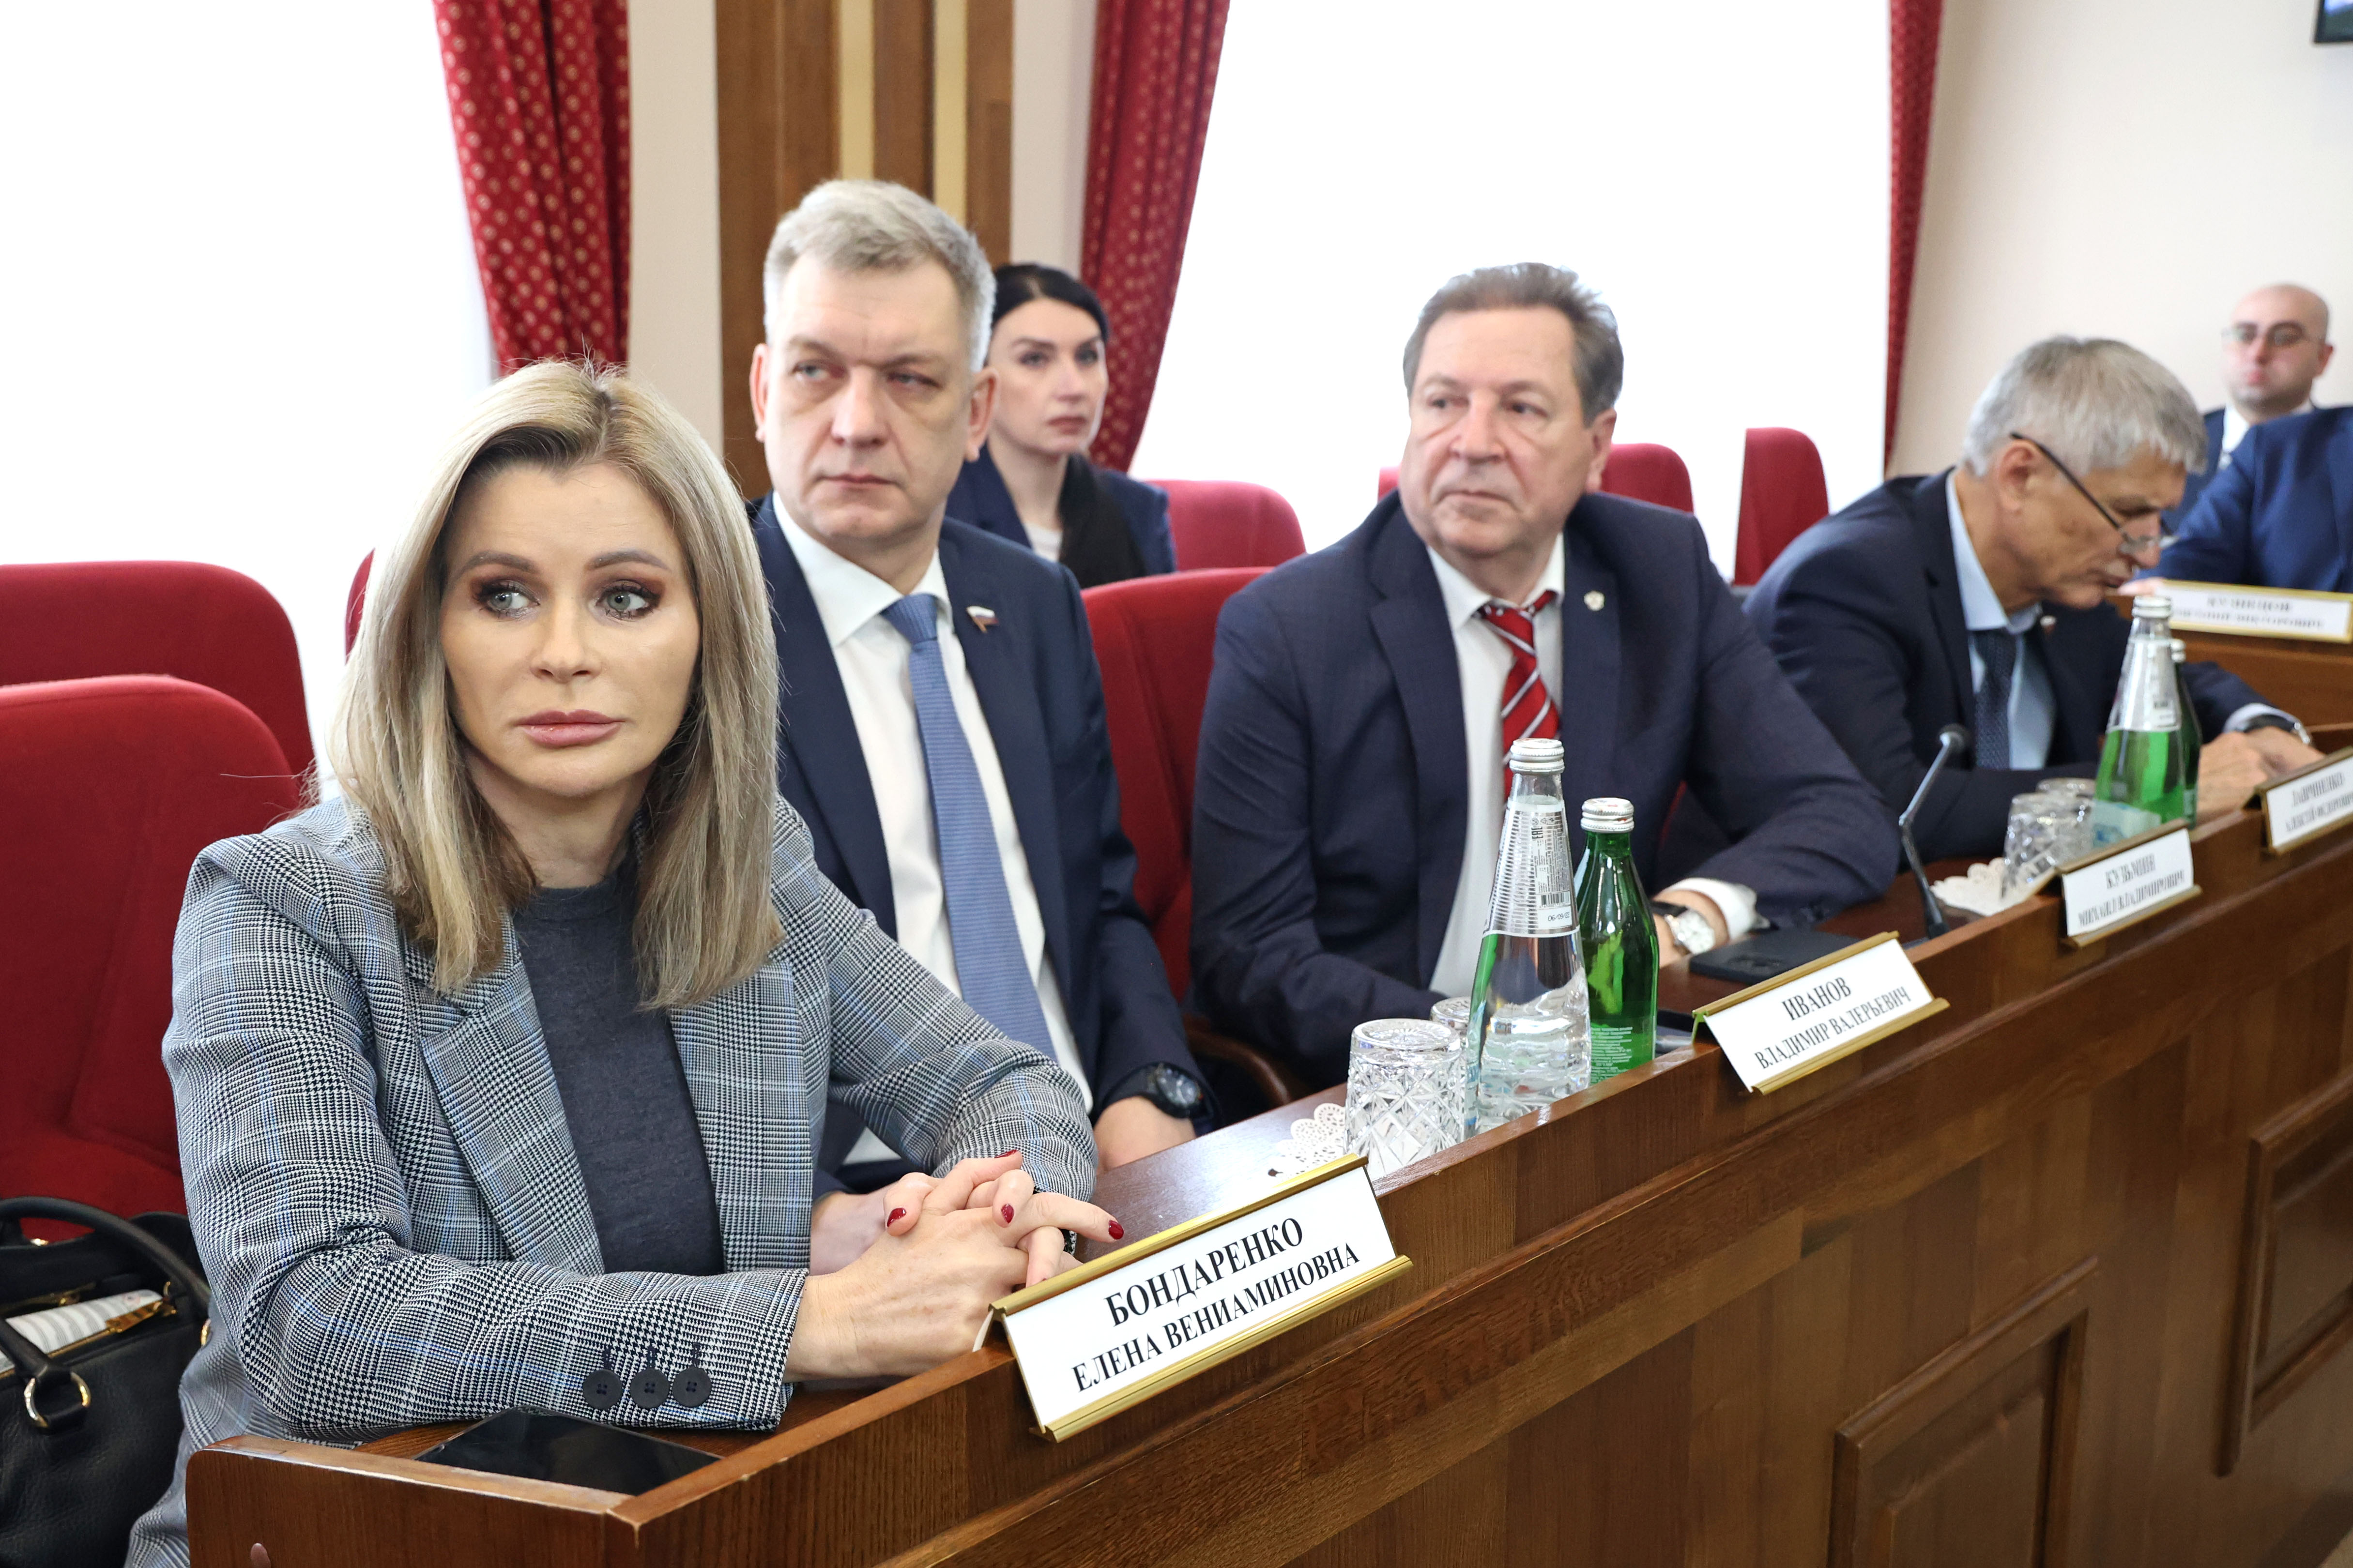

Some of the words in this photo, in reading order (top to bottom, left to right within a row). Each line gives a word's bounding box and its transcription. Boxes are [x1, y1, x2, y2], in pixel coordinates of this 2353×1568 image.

[1754, 1023, 1830, 1069] ВЛАДИМИР
[1832, 987, 1911, 1035] ВАЛЕРЬЕВИЧ
[1782, 977, 1851, 1020] ИВАНОВ
[1072, 1333, 1162, 1392] ЕЛЕНА
[1163, 1242, 1360, 1349] ВЕНИАМИНОВНА
[1104, 1218, 1303, 1327] БОНДАРЕНКО
